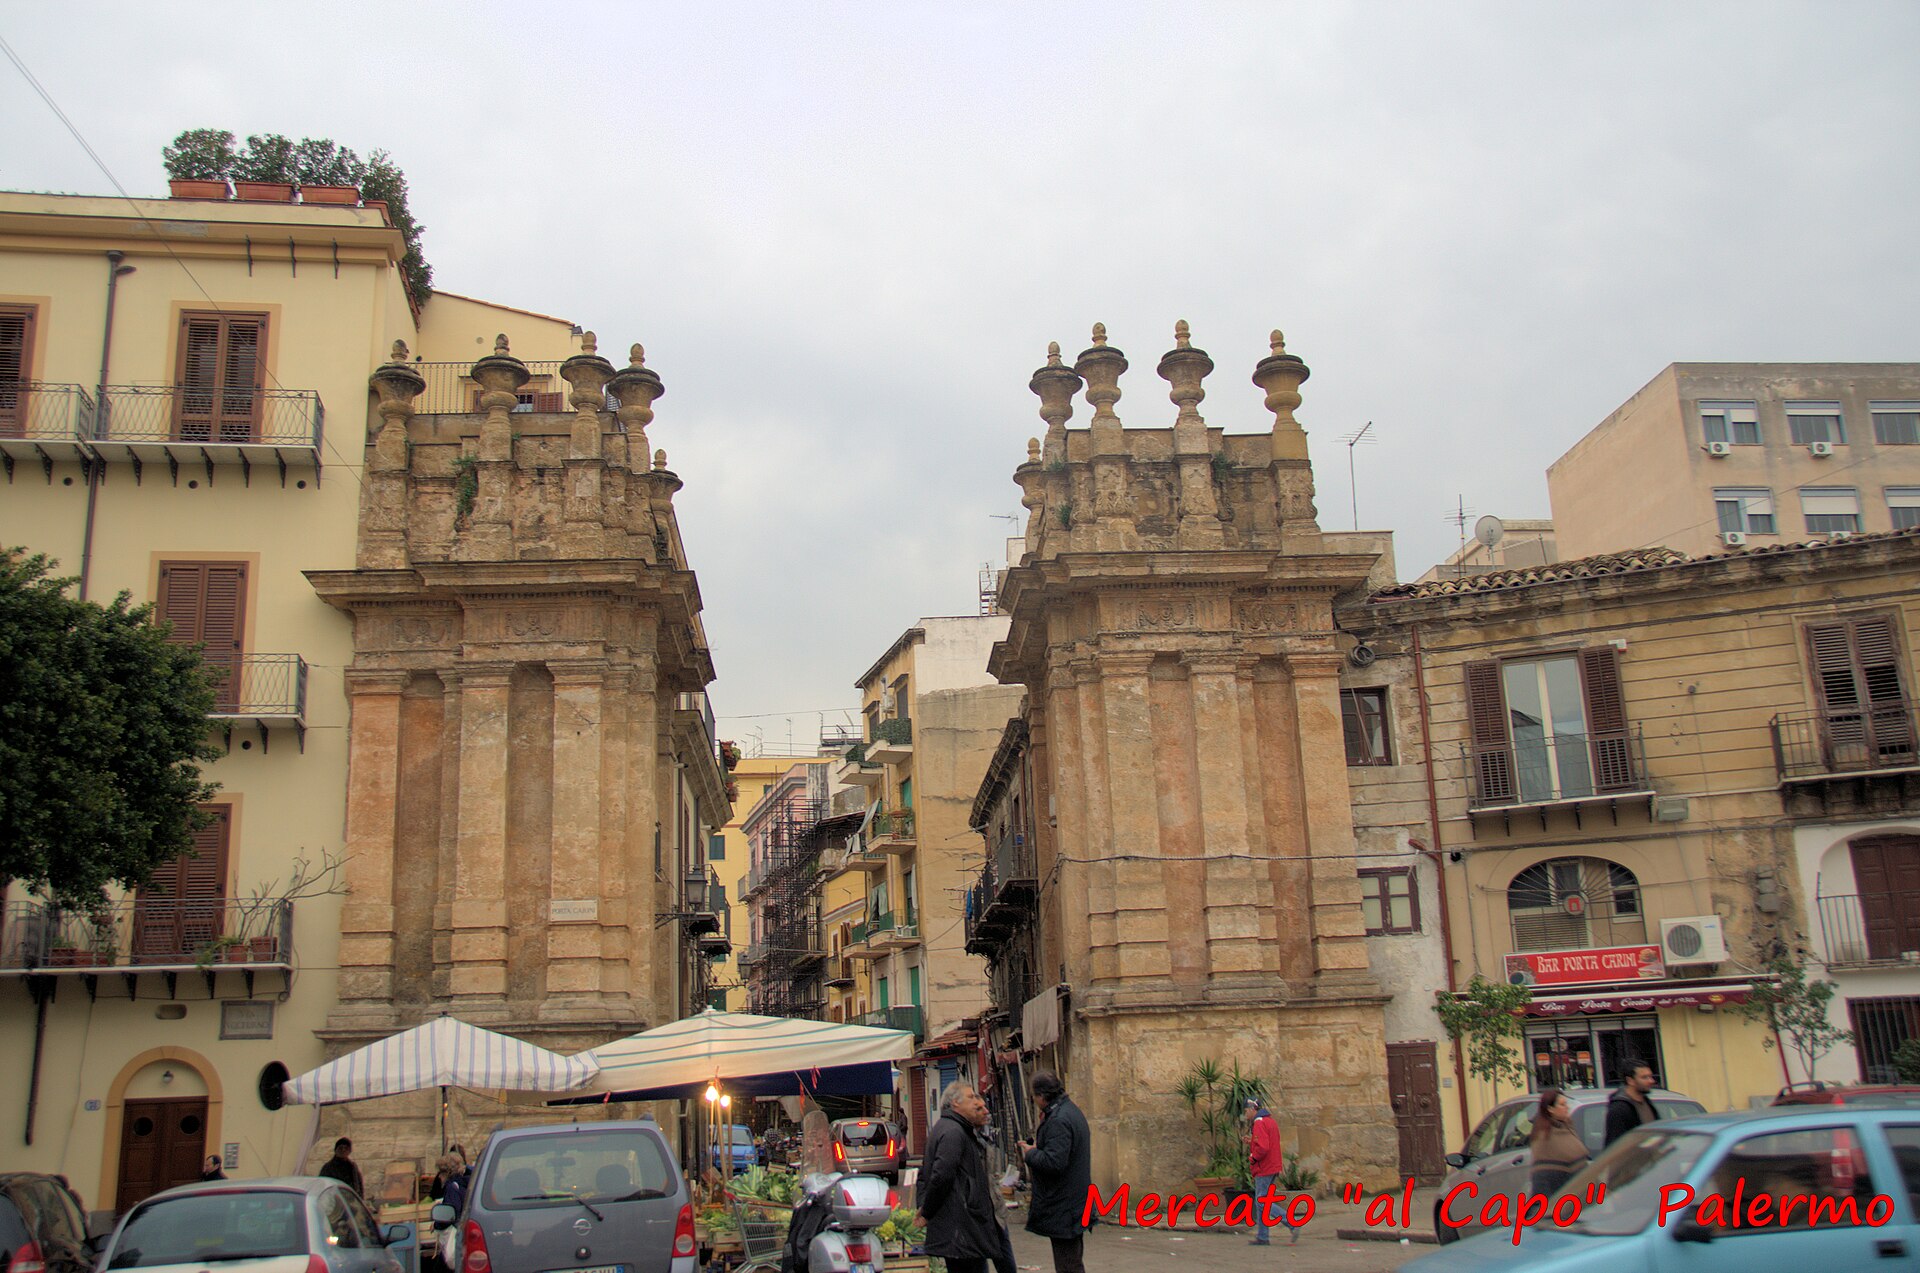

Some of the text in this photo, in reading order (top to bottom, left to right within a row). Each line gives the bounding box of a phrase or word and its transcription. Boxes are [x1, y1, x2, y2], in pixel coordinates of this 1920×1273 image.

[1537, 953, 1637, 973] BAR PORTA CARINI
[1540, 1001, 1567, 1011] Bar
[1578, 999, 1612, 1009] Porta
